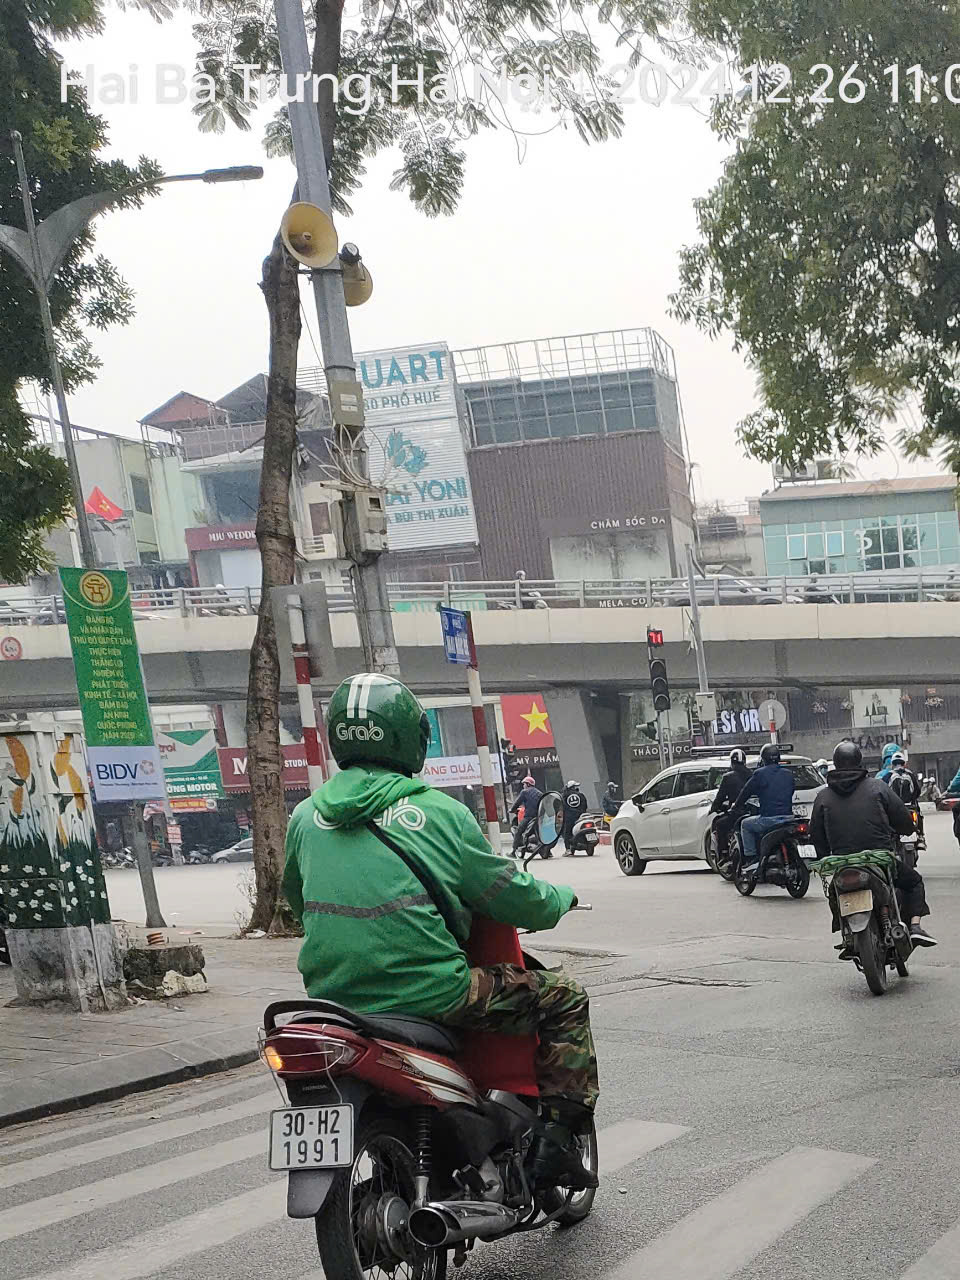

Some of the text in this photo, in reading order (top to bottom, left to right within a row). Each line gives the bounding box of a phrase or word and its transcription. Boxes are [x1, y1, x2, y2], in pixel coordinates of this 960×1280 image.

[625, 515, 646, 527] SÓC
[335, 720, 384, 742] Grab
[96, 763, 139, 780] BIDV
[187, 782, 217, 792] MOTOR
[282, 1109, 341, 1137] 30-H2
[283, 1137, 340, 1166] 1991
